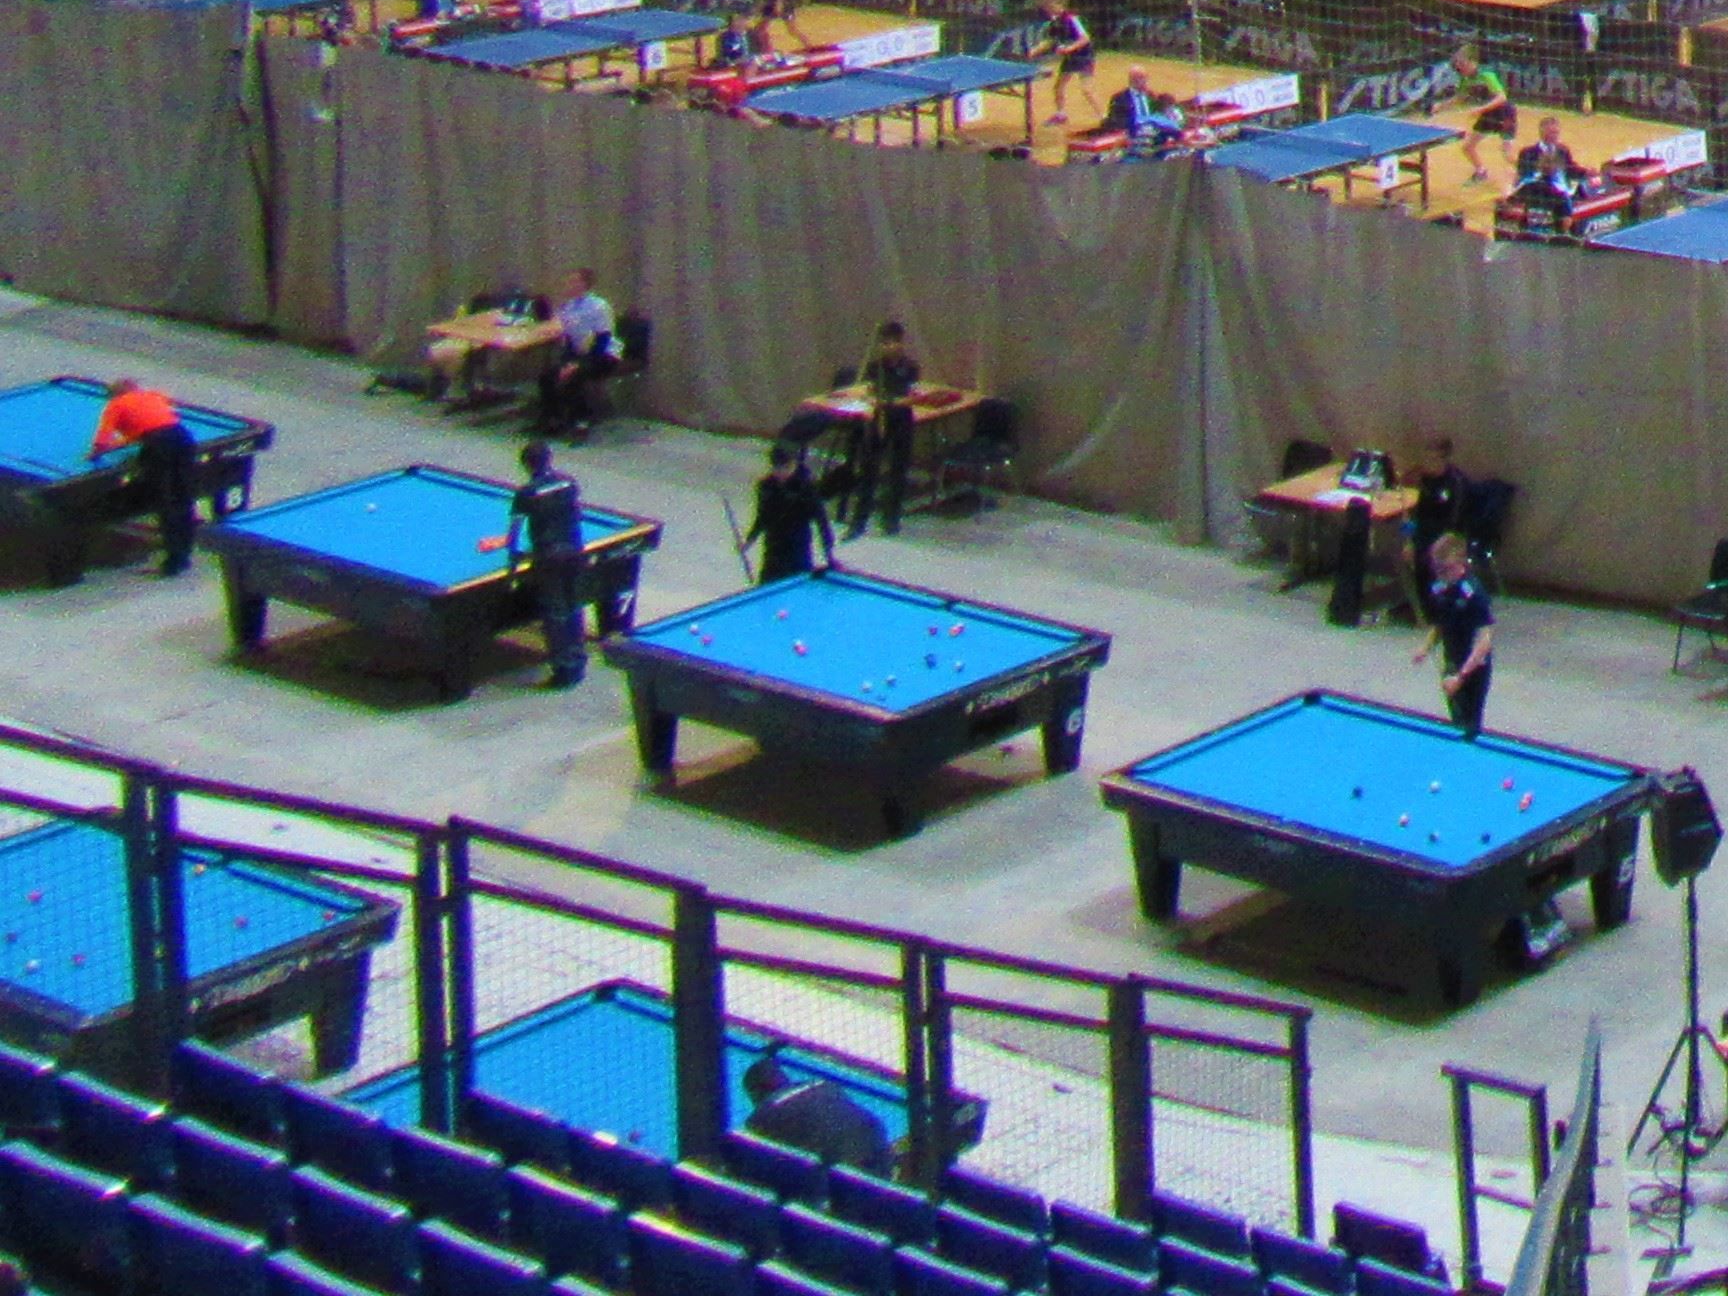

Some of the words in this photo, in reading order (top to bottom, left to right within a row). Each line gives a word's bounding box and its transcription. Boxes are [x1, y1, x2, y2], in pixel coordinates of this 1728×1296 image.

[1334, 59, 1461, 114] STIGA
[1598, 69, 1701, 114] STIGA
[618, 589, 635, 615] 7
